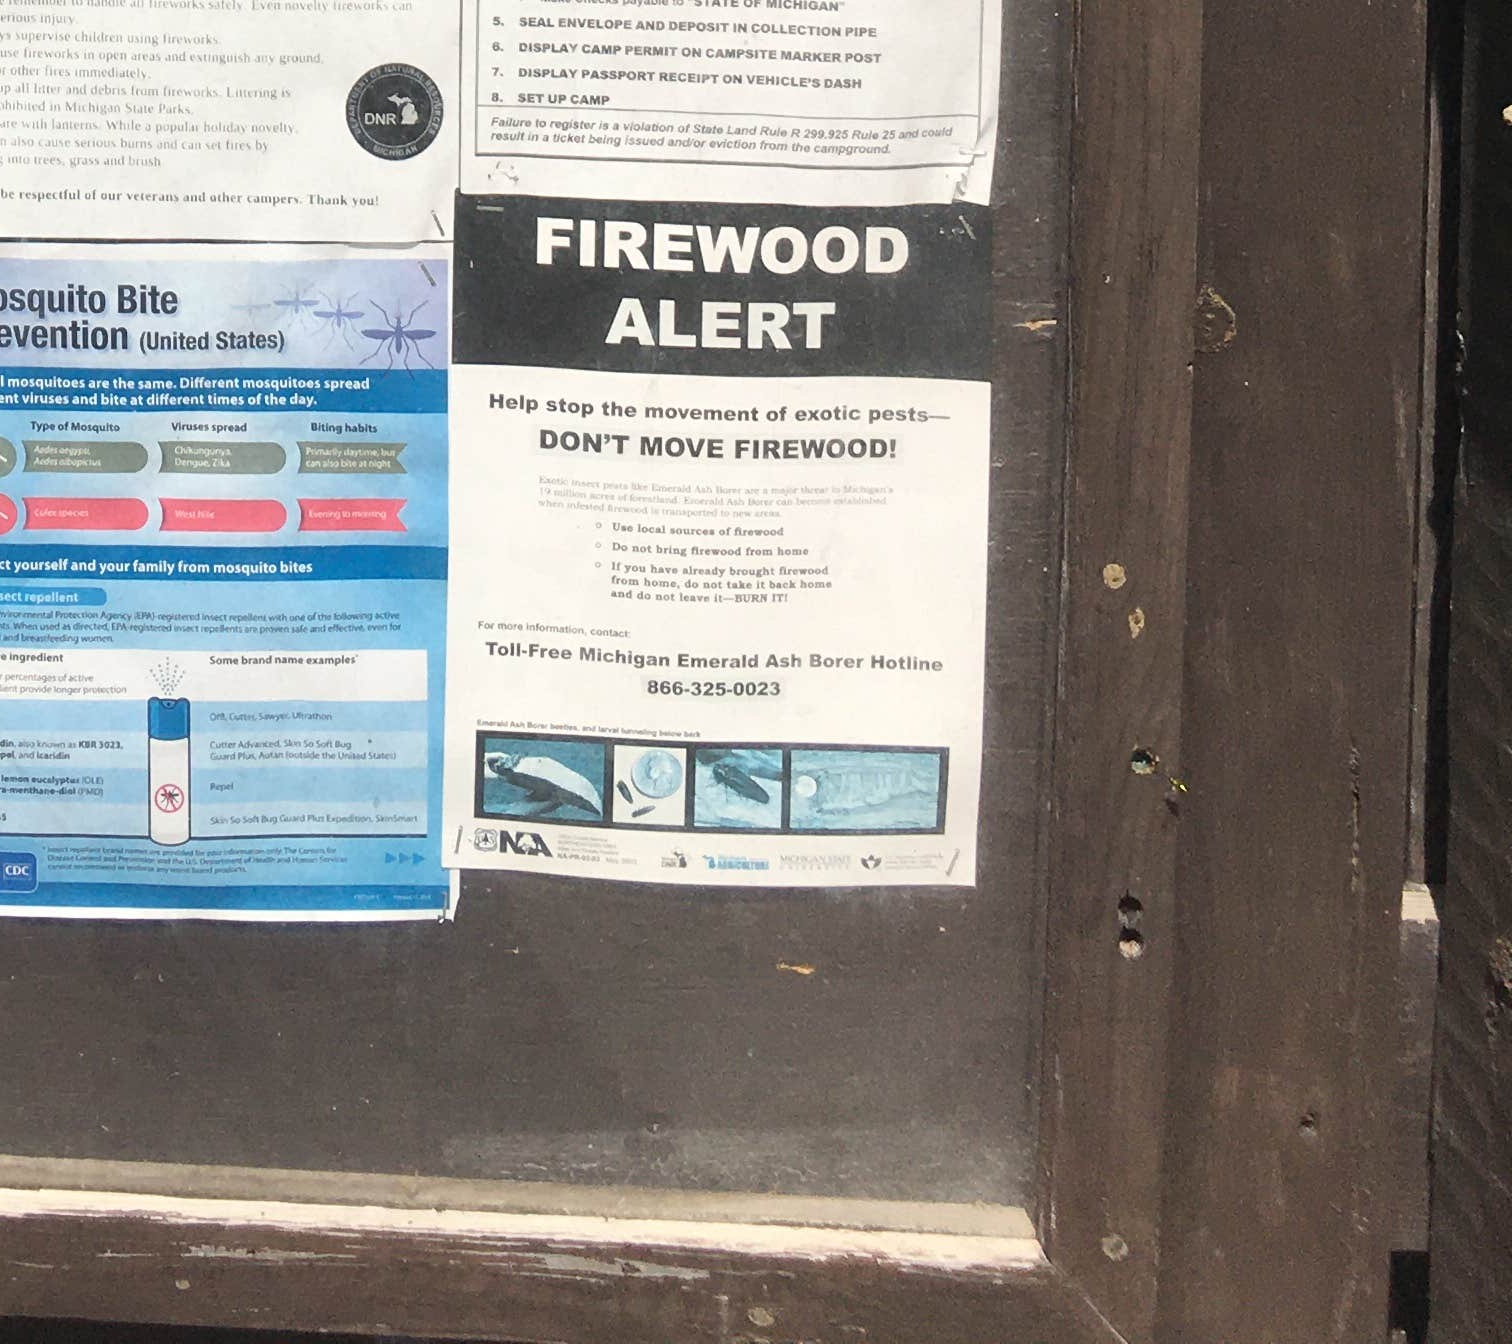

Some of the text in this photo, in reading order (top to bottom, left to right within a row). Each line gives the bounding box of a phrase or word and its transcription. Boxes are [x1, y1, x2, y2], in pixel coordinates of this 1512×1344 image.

[365, 112, 396, 125] DNR
[535, 218, 909, 273] FIREWOOD
[116, 284, 178, 314] Bite
[604, 298, 836, 349] ALERT
[139, 331, 210, 354] (United
[215, 330, 285, 352] States)
[489, 393, 539, 414] Help
[545, 398, 594, 418] stop
[601, 401, 637, 417] the
[644, 406, 759, 421] movement
[765, 405, 788, 422] of
[794, 405, 860, 421] exotic
[639, 436, 724, 458] MOVE
[734, 438, 896, 459] FIREWOOD!
[484, 641, 943, 671] Toll-Free Michigan Emerald Ash Borer Hotline
[647, 680, 781, 696] 866-325-0023
[5, 864, 29, 876] CDC
